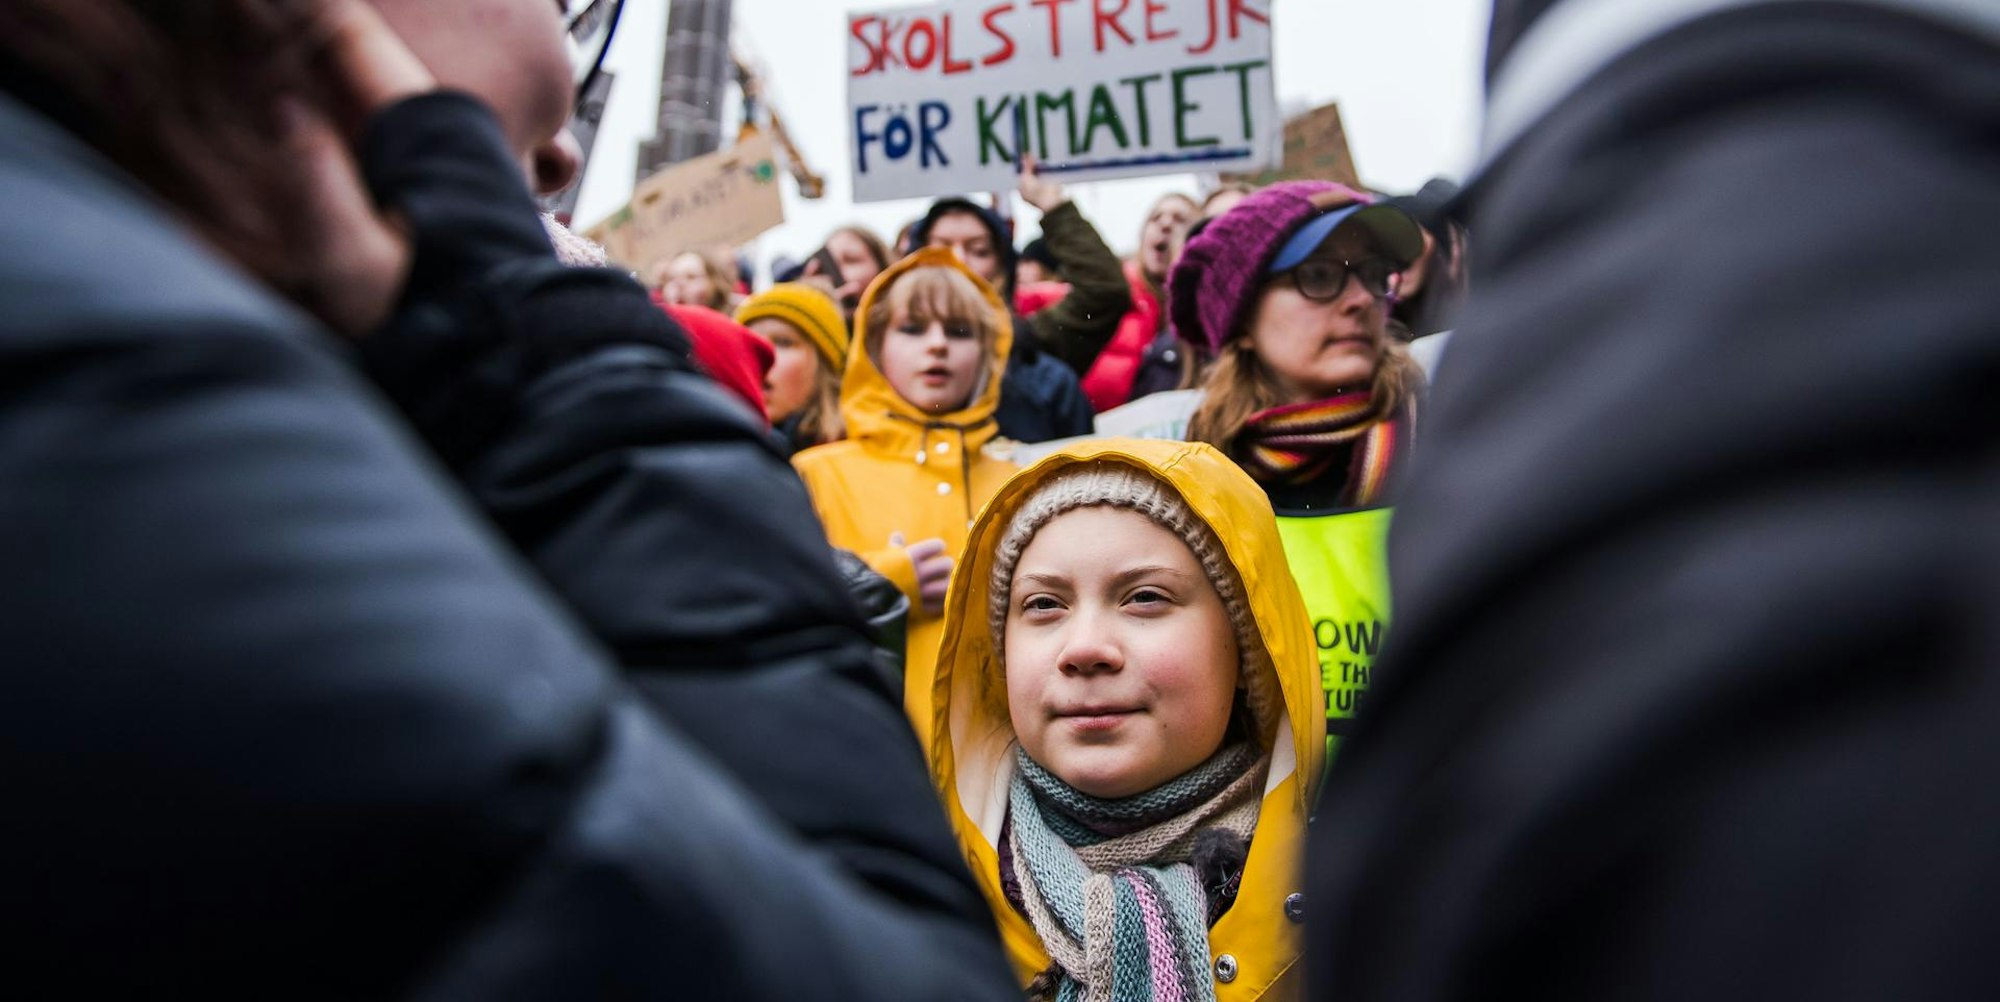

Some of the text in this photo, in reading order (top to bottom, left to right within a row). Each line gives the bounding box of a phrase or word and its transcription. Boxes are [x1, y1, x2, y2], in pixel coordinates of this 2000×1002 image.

[855, 101, 953, 173] FÖR
[1315, 619, 1381, 656] OW
[1340, 662, 1374, 686] TH
